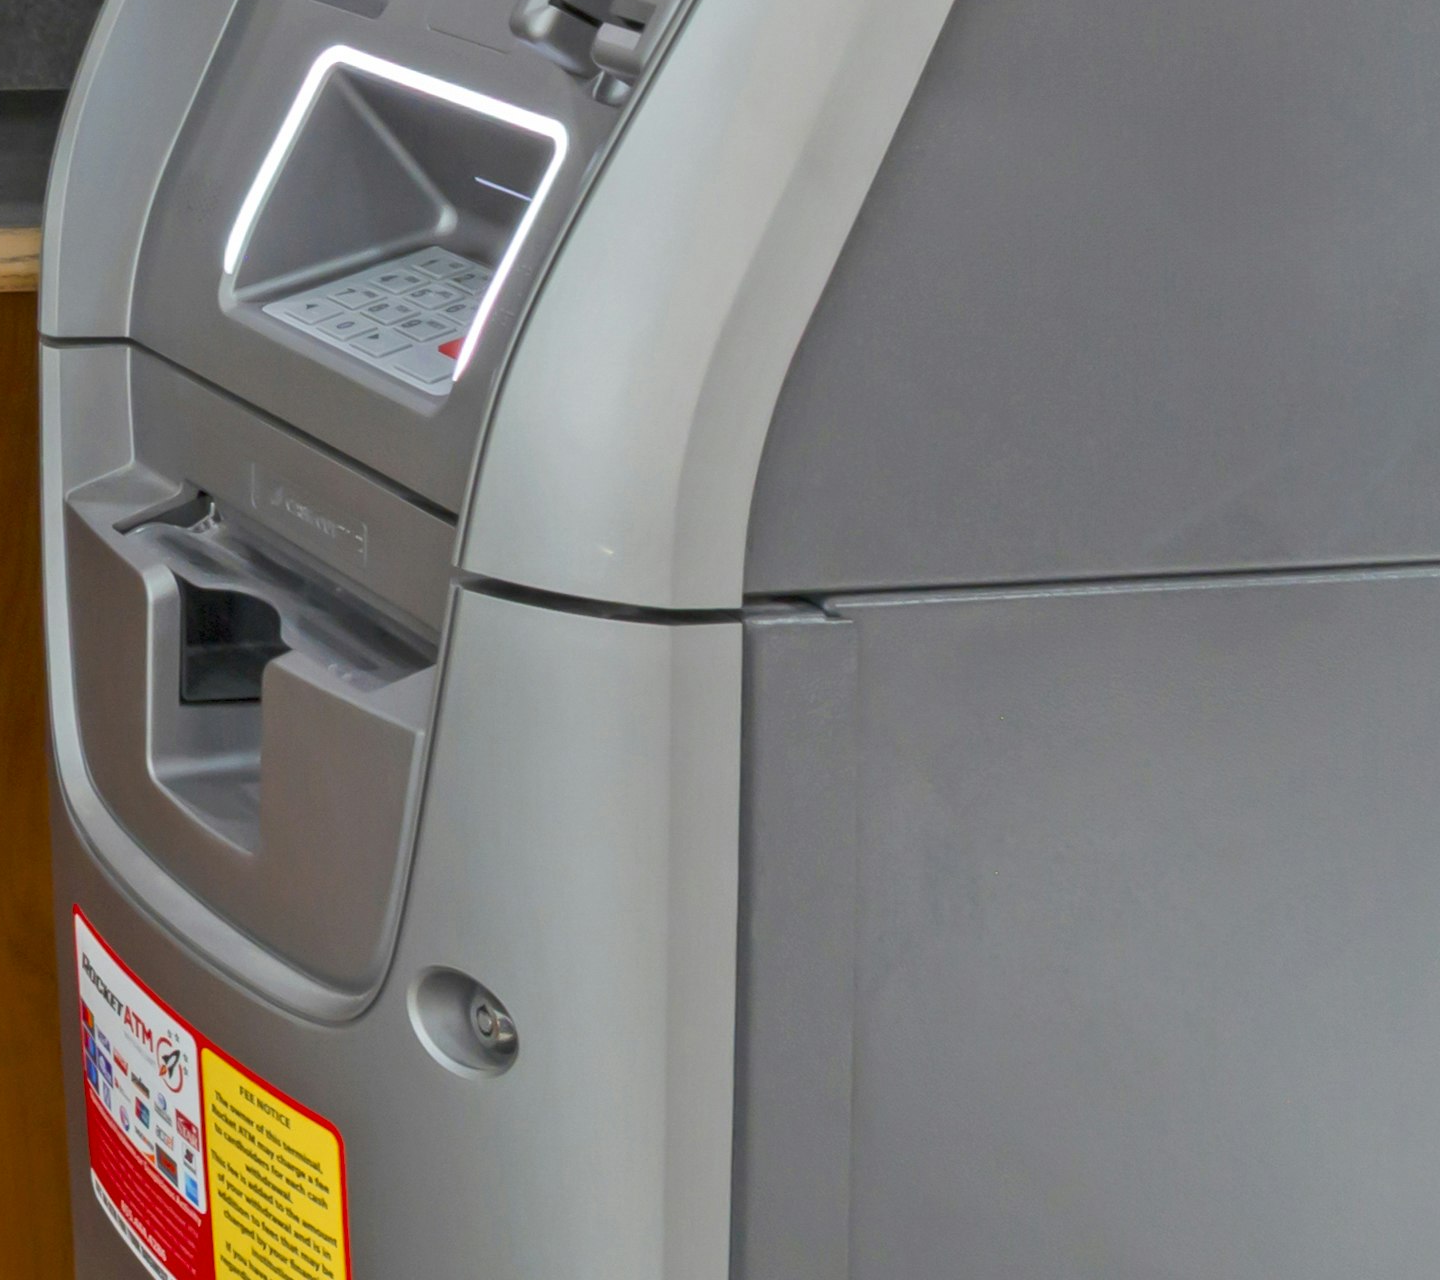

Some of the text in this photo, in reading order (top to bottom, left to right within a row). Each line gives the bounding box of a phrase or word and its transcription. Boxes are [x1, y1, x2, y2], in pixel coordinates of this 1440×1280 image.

[82, 951, 124, 1016] ROCKET
[124, 1005, 153, 1053] ATM
[239, 1085, 290, 1129] FEE NOTICE
